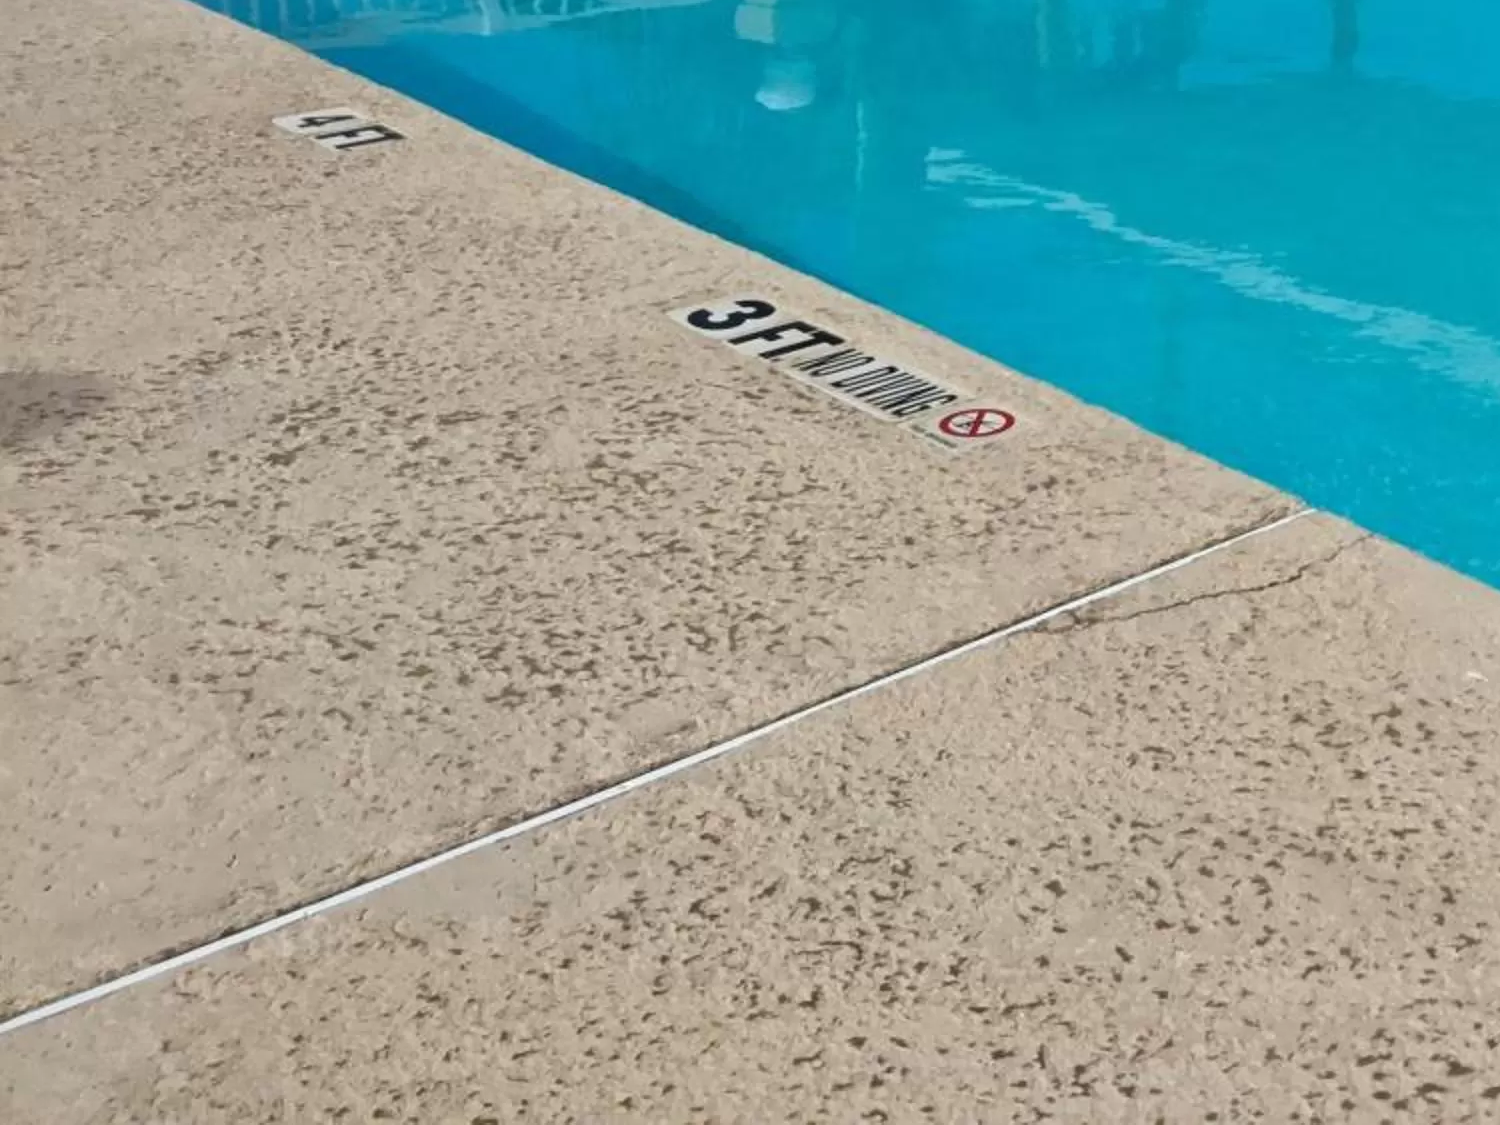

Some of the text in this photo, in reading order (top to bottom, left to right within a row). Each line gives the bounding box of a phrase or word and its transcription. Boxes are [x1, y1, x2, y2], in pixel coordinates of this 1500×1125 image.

[296, 113, 408, 150] 4 FT
[686, 298, 959, 419] 3 FT NO DIVING
